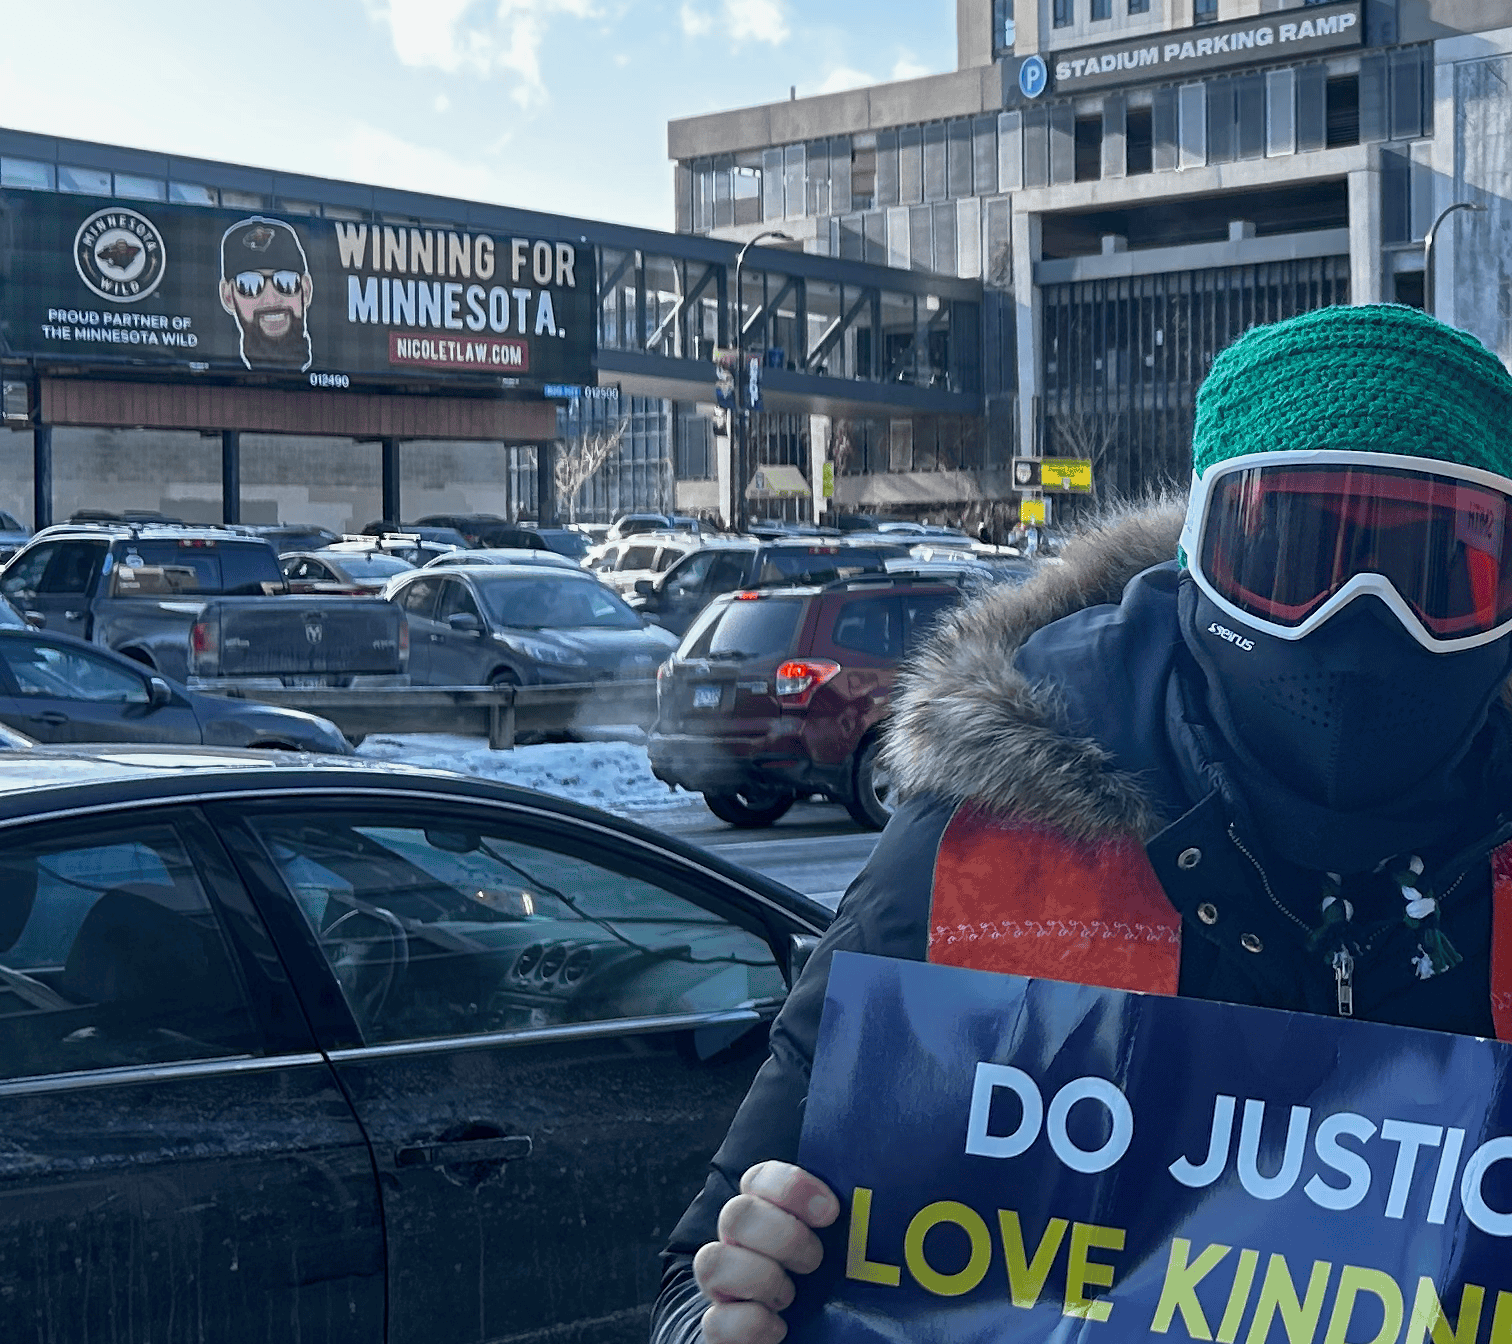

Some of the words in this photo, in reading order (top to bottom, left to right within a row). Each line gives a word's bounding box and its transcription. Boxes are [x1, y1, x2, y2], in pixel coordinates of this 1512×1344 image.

[1055, 47, 1159, 81] STADIUM
[1164, 27, 1274, 63] PARKING
[1279, 12, 1357, 43] RAMP
[82, 214, 158, 253] MINNESOTA
[335, 221, 496, 280] WINNING
[511, 237, 576, 288] FOR
[100, 276, 140, 296] WILD
[348, 274, 566, 339] MINNESOTA.
[41, 324, 72, 341] THE
[74, 328, 160, 346] MINNESOTA
[161, 331, 198, 348] WILD
[48, 308, 100, 326] PROUD
[103, 311, 169, 330] PARTNER
[172, 316, 192, 331] OF
[397, 337, 522, 366] NICOLETLAW.COM
[965, 1061, 1133, 1174] DO
[845, 1188, 1127, 1318] LOVE
